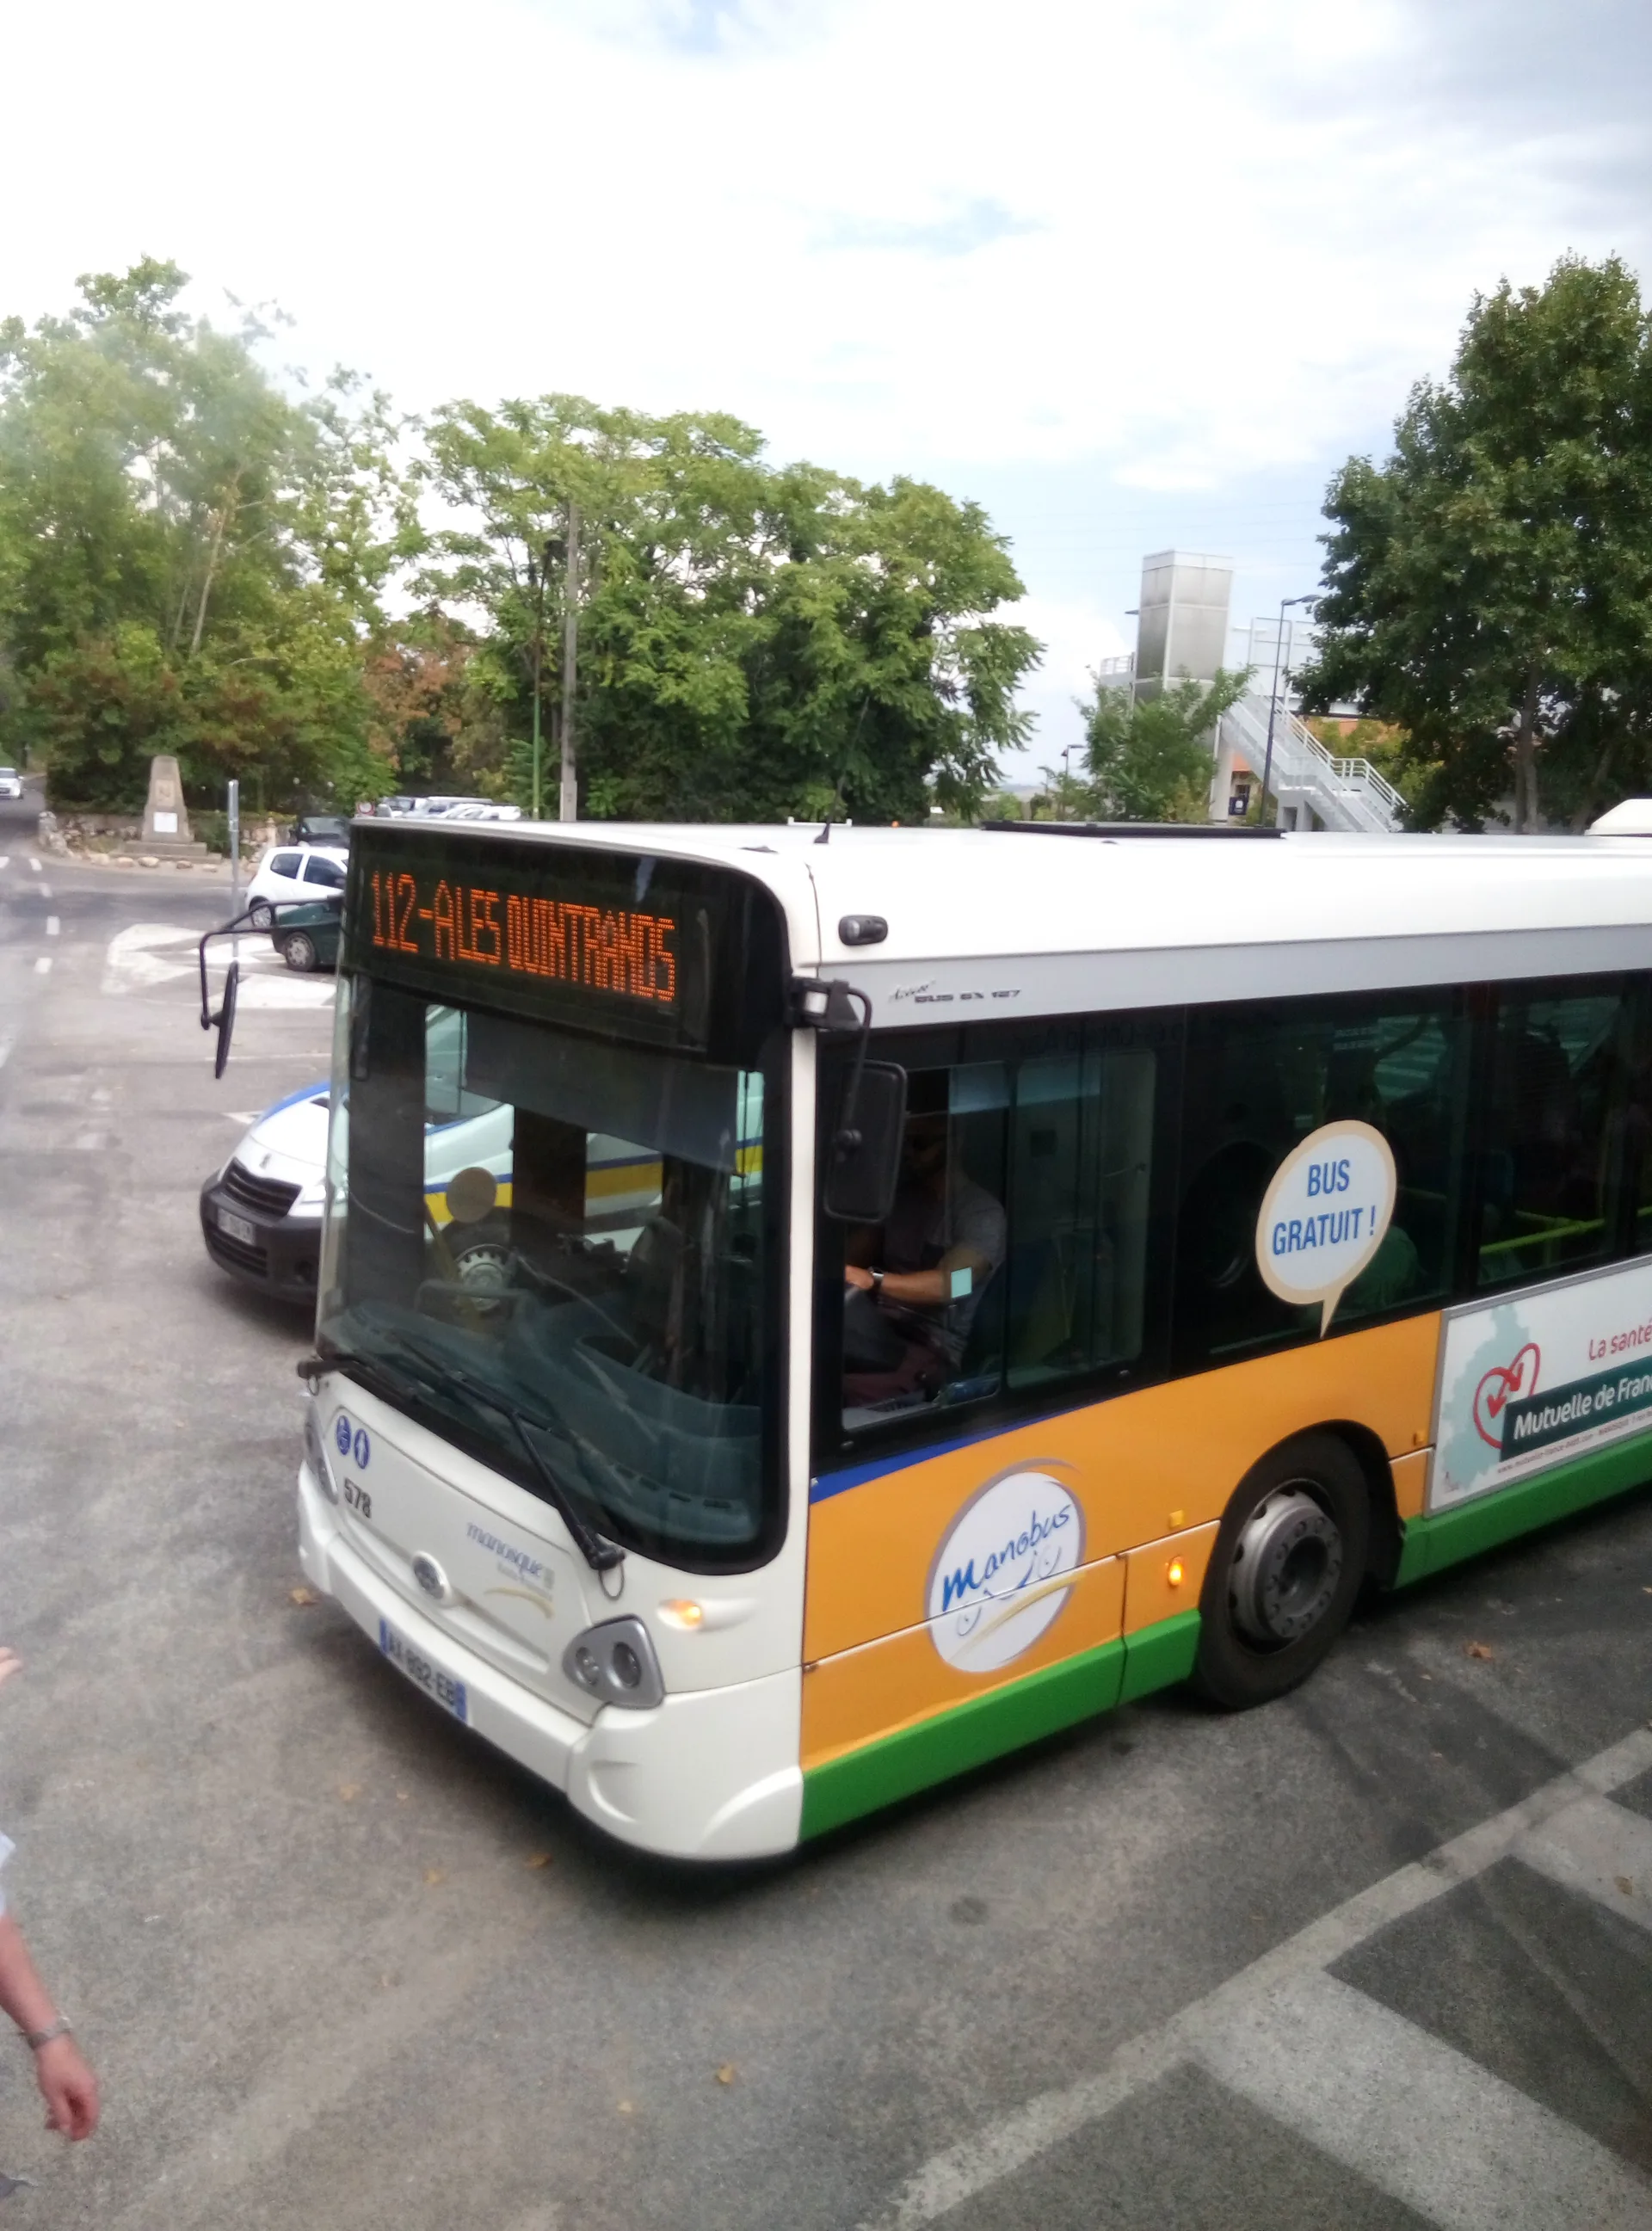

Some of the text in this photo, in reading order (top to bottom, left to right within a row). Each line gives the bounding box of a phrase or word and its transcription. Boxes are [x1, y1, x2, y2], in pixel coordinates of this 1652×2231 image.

[506, 894, 676, 1002] QUINTRANDS
[1306, 1158, 1351, 1198] BUS
[1272, 1205, 1377, 1256] GRATUIT !
[1588, 1316, 1652, 1361] La santé
[1513, 1374, 1652, 1441] Mutuelle de Fran
[343, 1476, 373, 1519] 578
